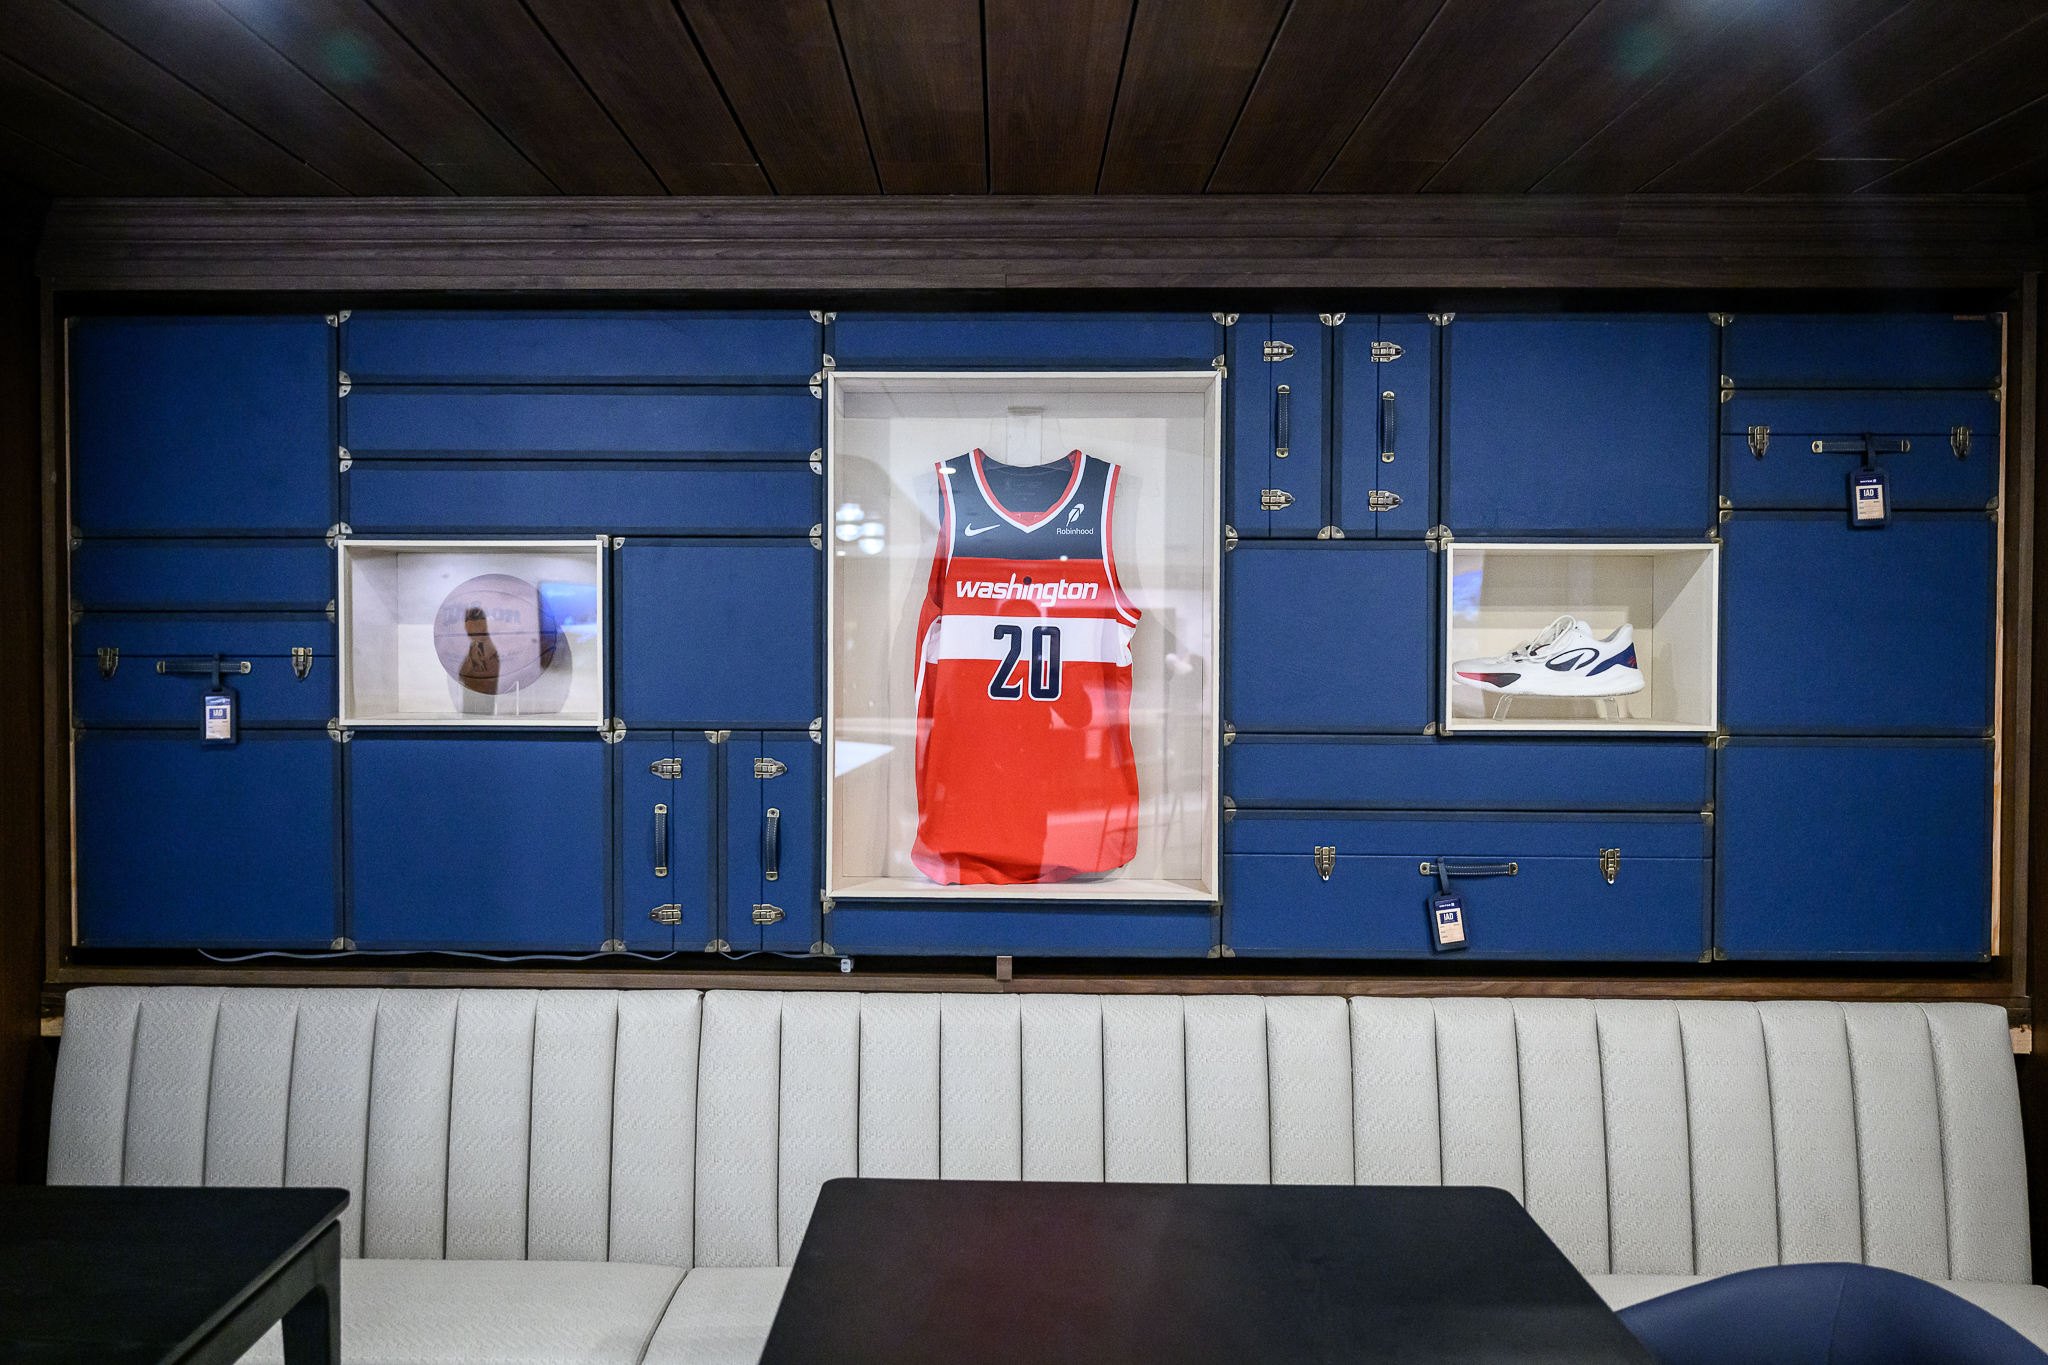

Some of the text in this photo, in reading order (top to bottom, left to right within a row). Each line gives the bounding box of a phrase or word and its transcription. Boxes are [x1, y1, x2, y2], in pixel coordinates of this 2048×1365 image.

[1863, 489, 1874, 497] IAD
[956, 572, 1099, 608] washington
[988, 623, 1062, 702] 20
[1443, 912, 1454, 920] IAD
